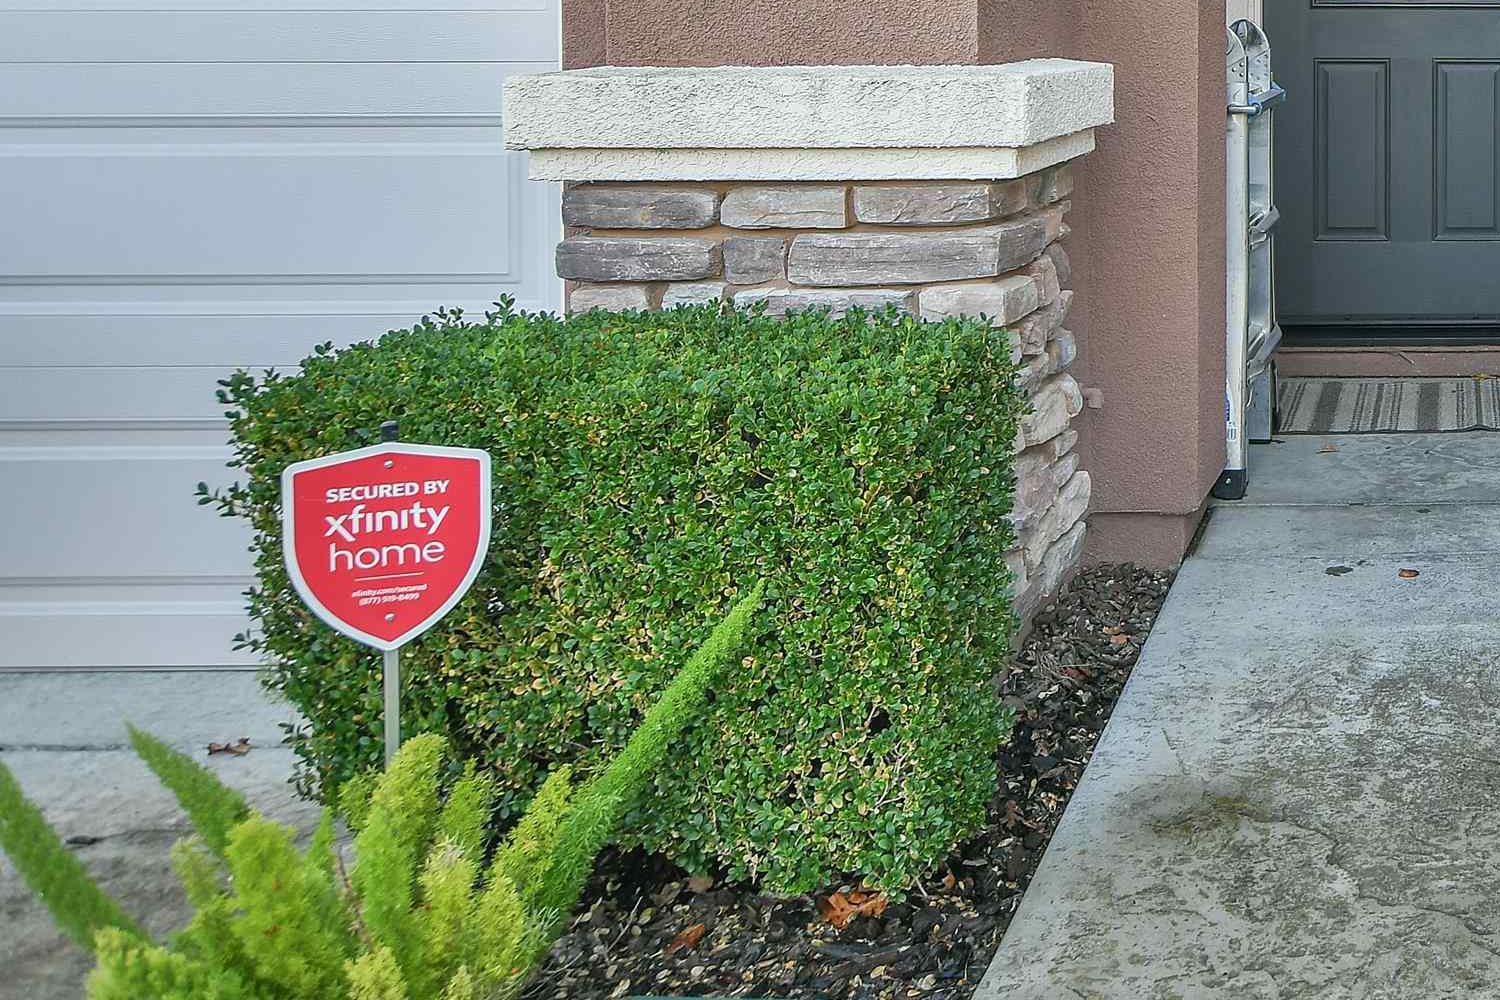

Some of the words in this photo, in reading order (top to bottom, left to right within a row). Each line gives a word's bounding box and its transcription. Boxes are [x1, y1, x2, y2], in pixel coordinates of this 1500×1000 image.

[325, 482, 419, 504] SECURED
[424, 479, 451, 495] BY
[324, 501, 451, 542] xfinity
[328, 541, 445, 572] home
